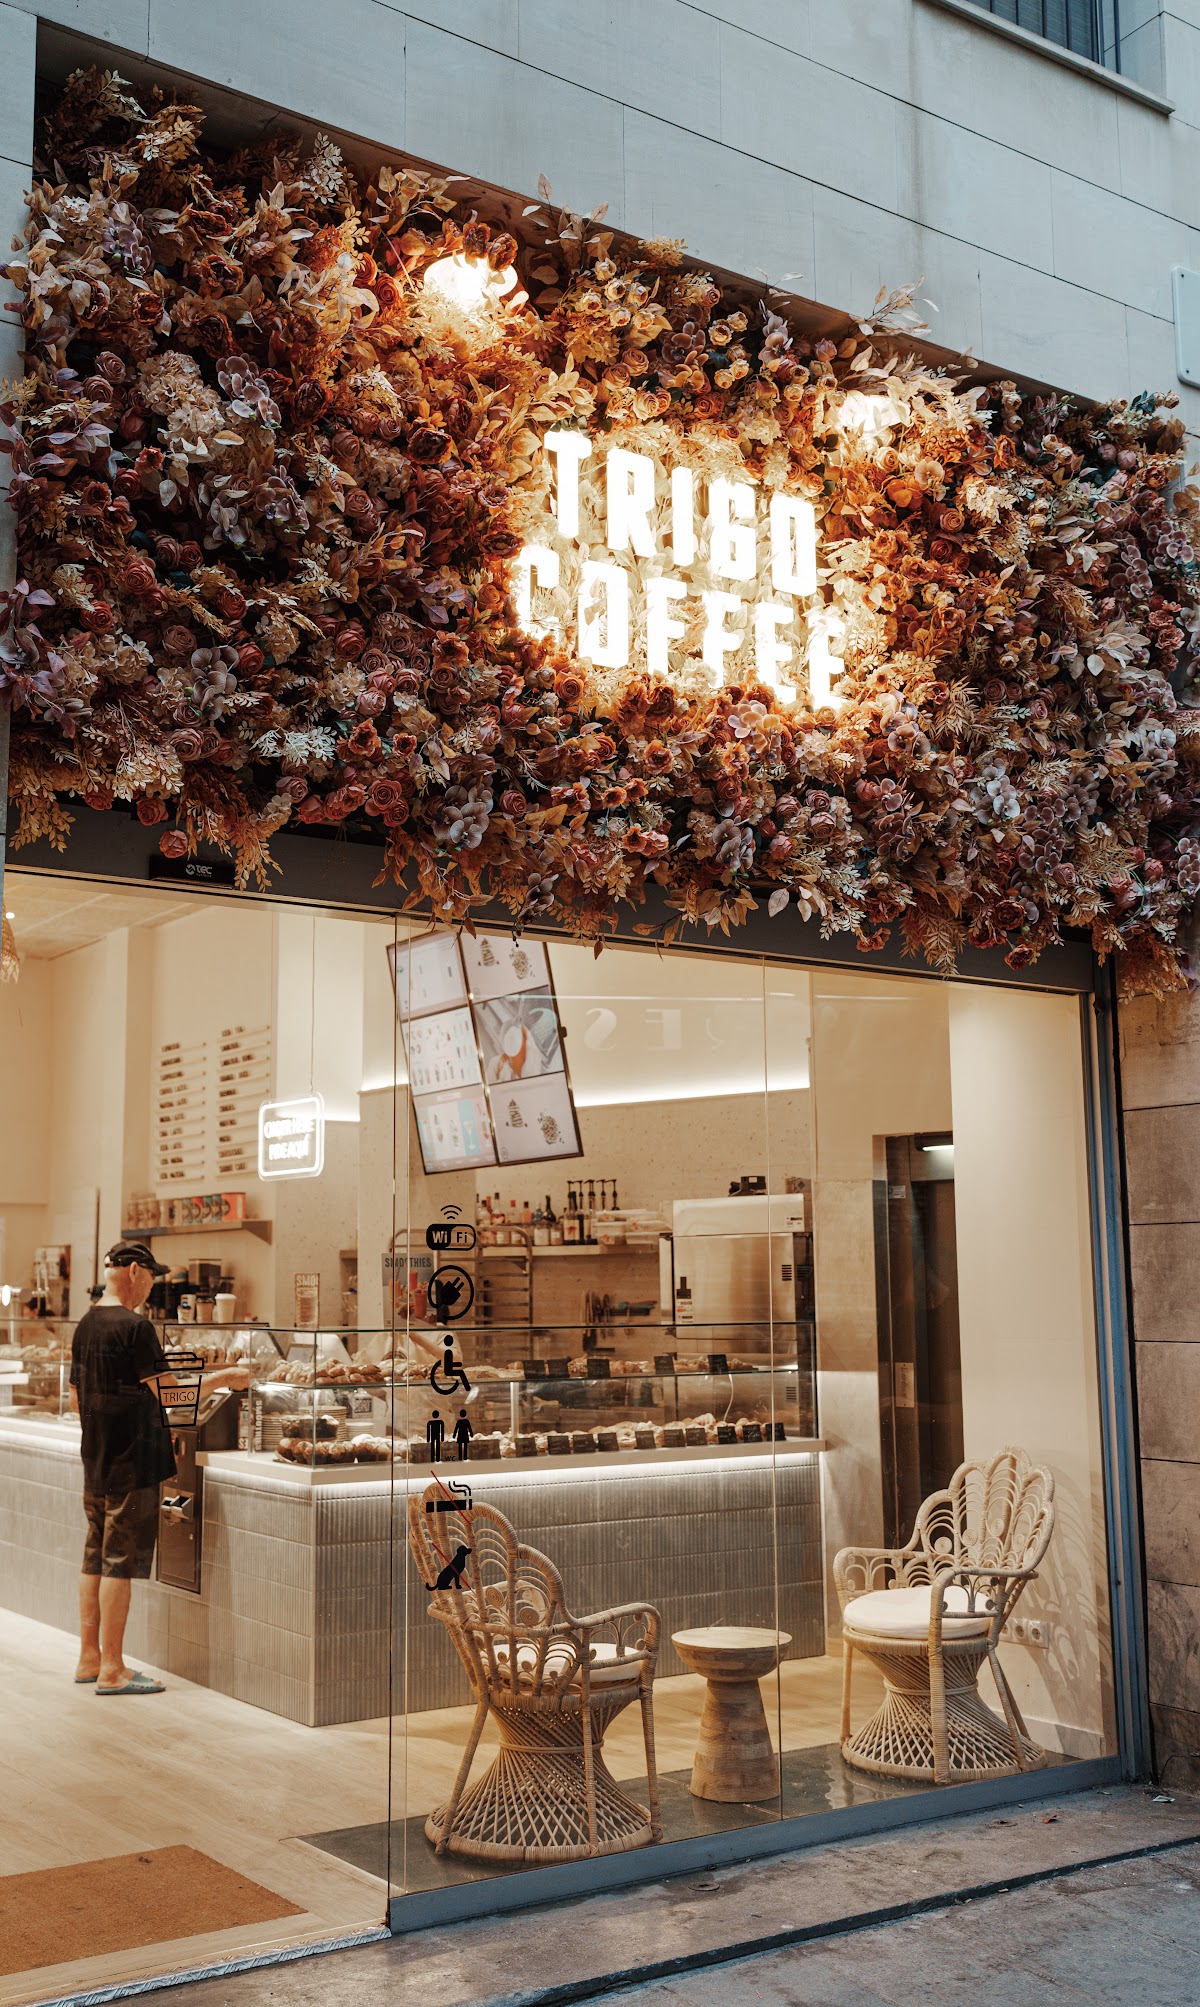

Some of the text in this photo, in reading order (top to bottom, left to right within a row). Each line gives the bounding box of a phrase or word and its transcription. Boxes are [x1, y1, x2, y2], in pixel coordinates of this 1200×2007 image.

[544, 430, 818, 597] TRIGO
[512, 545, 848, 710] COFFEE
[431, 1230, 468, 1244] Wi Fi
[163, 1391, 196, 1402] TRIGO
